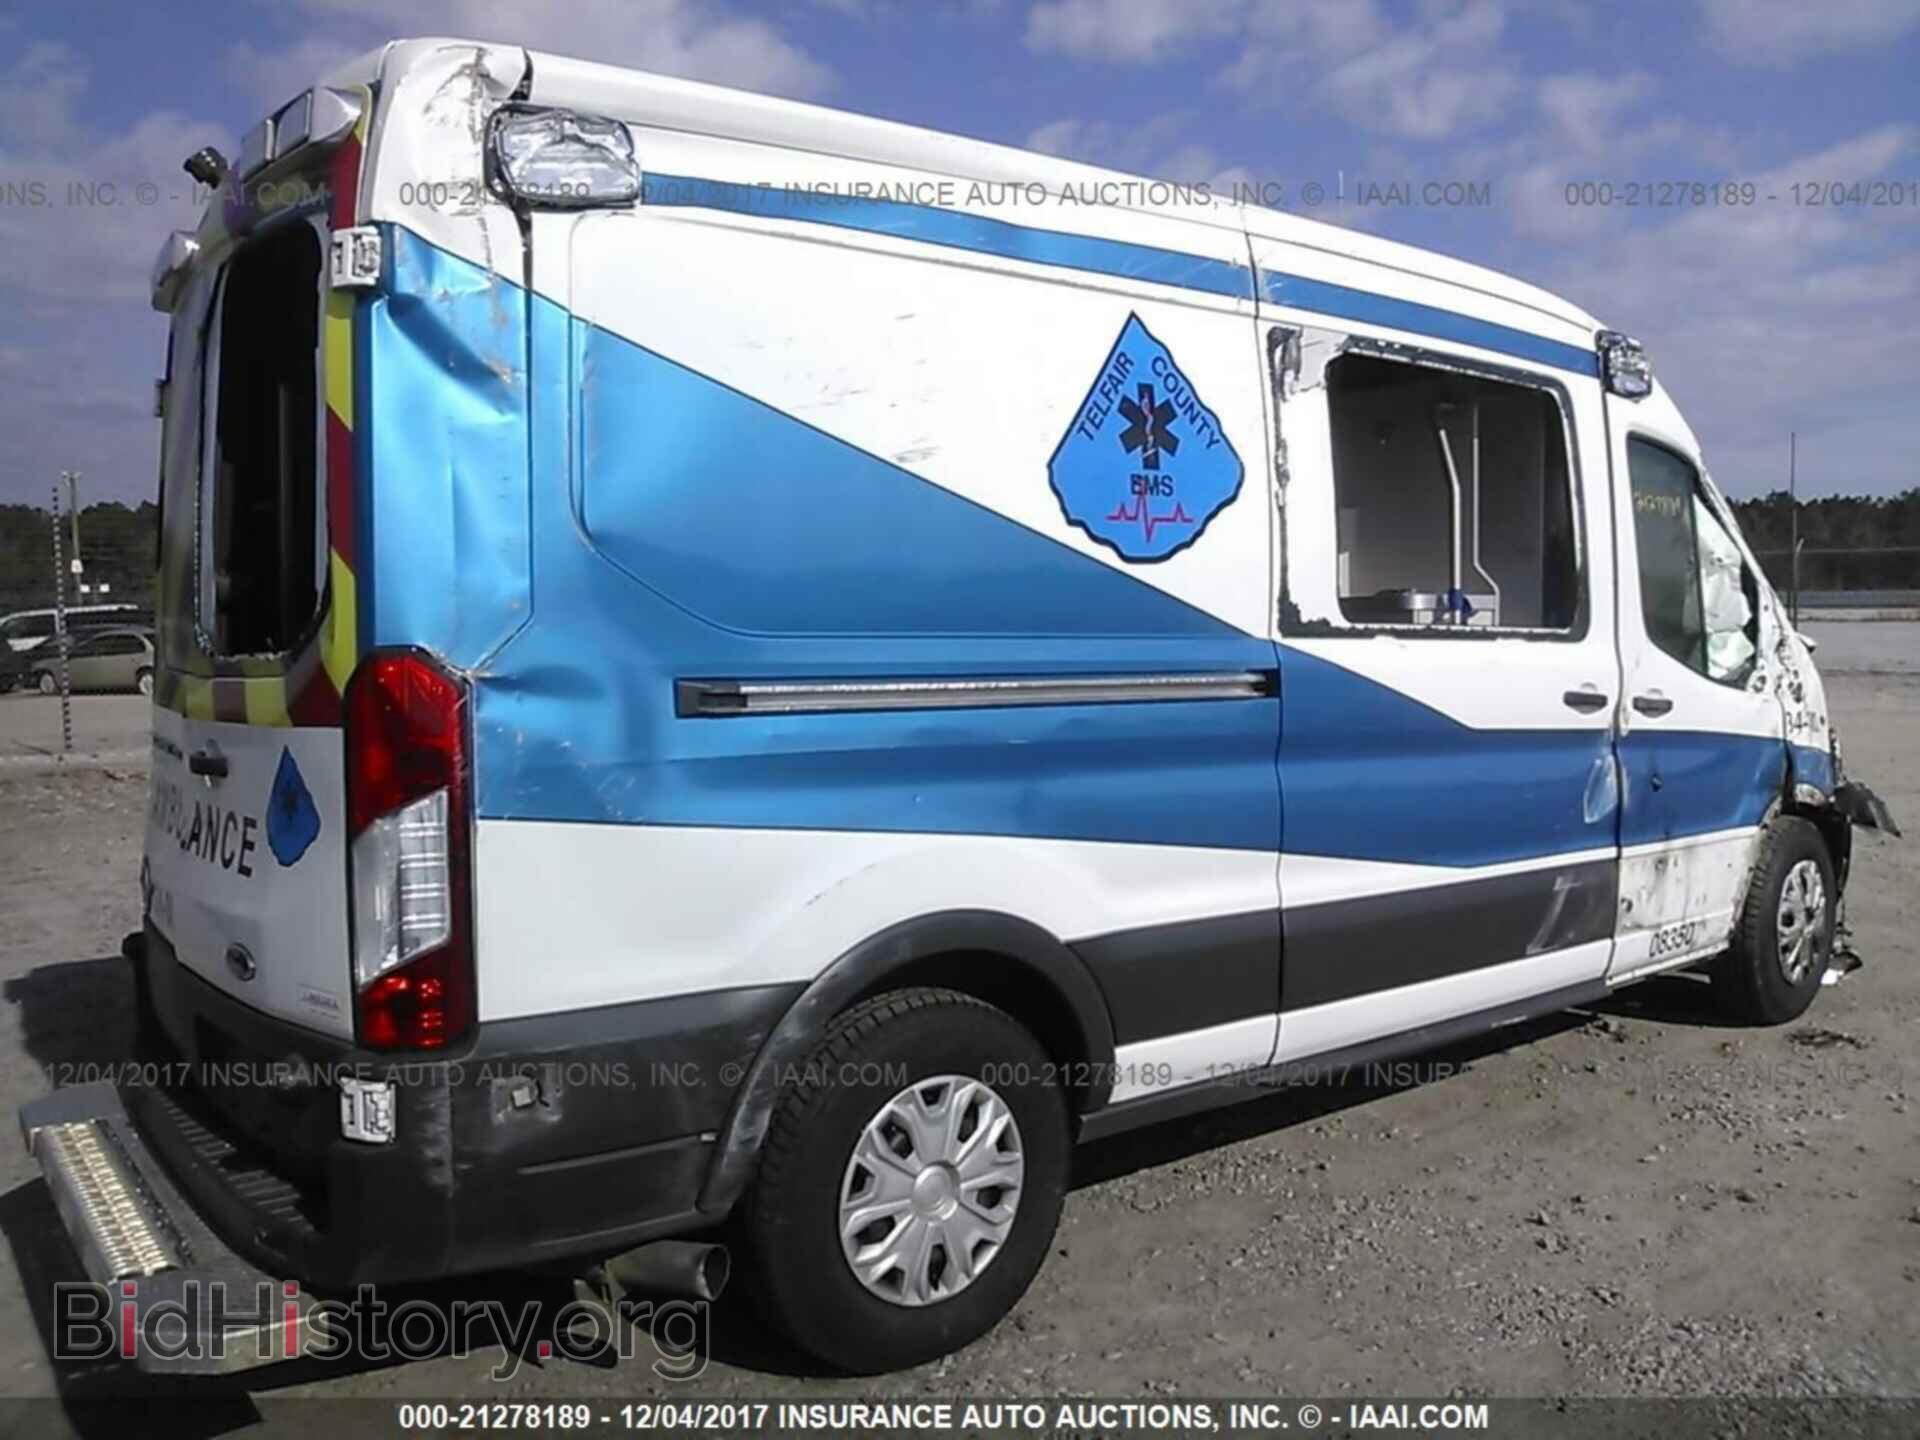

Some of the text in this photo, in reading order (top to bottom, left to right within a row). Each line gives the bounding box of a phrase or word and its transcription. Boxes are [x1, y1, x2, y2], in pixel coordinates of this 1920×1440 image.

[1075, 351, 1221, 450] TELFAIR COUNTY
[1130, 474, 1174, 497] EMS
